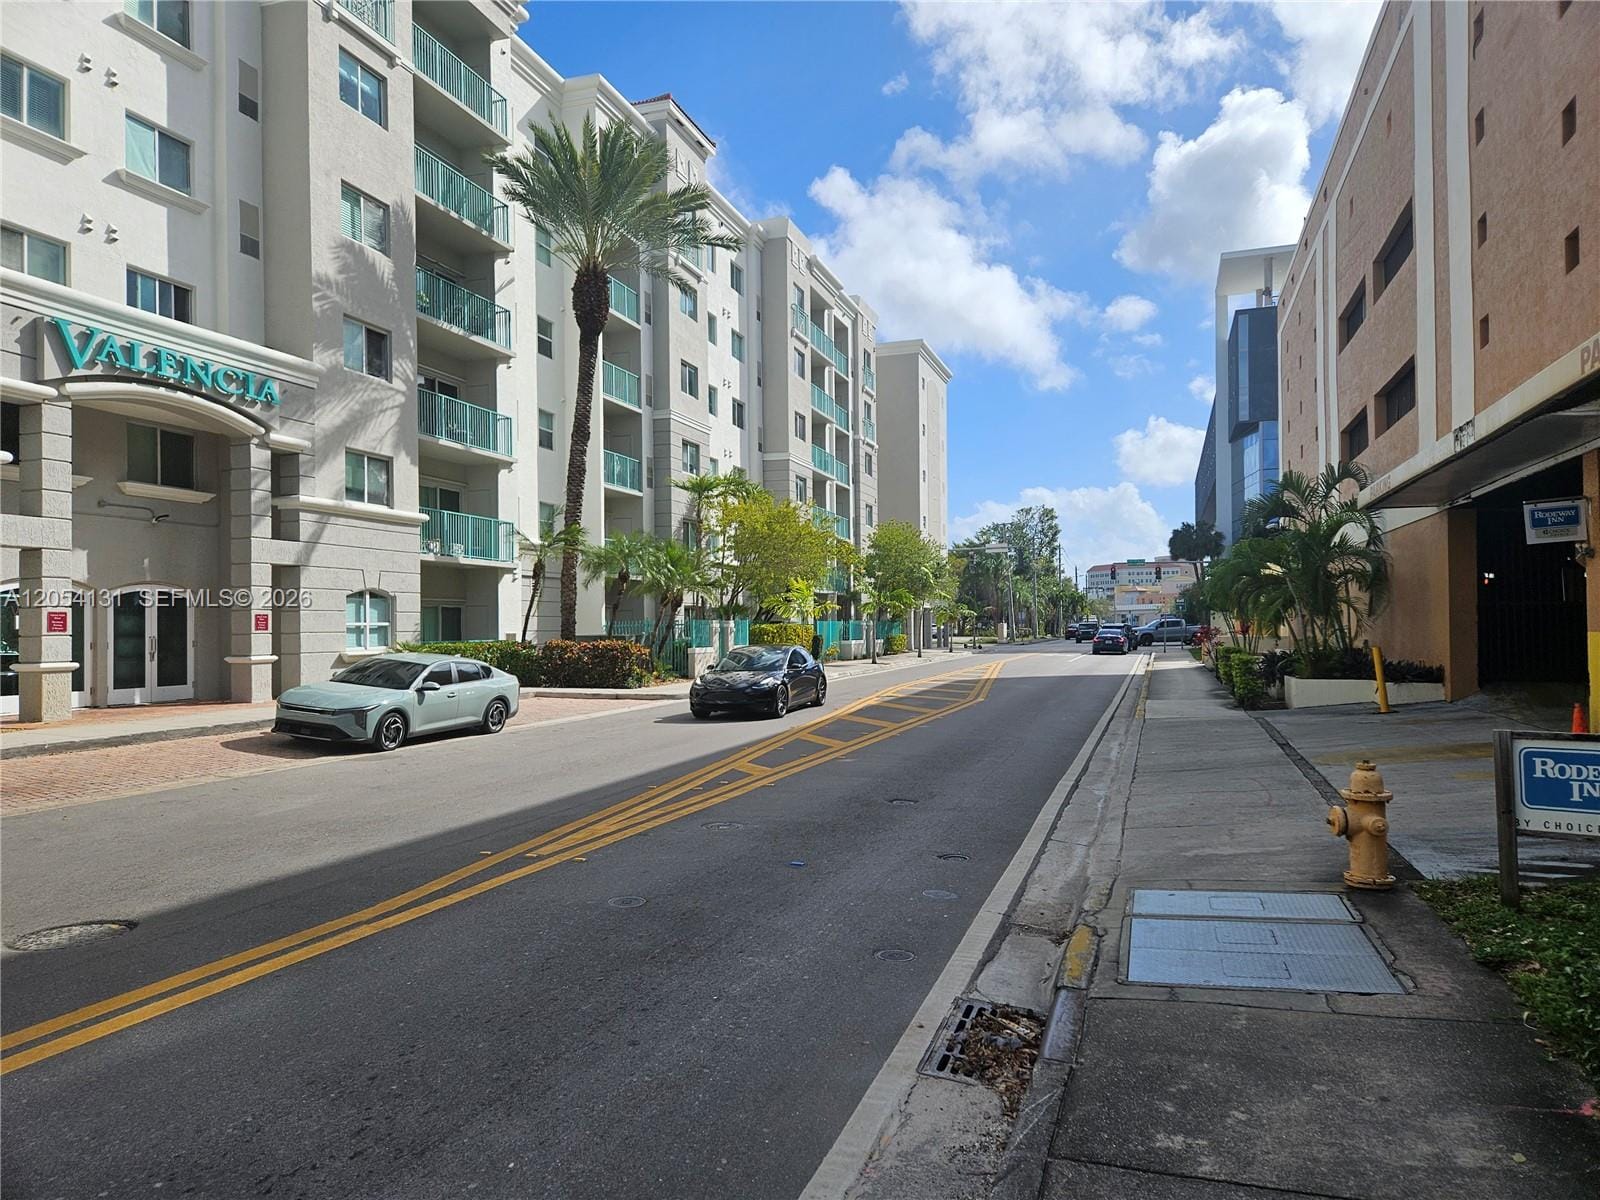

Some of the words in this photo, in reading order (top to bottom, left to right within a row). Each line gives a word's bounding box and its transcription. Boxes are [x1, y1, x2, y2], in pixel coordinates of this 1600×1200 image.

[50, 316, 282, 406] VALENCIA
[1534, 509, 1576, 519] RODEWAY
[1543, 820, 1600, 834] CHOIC
